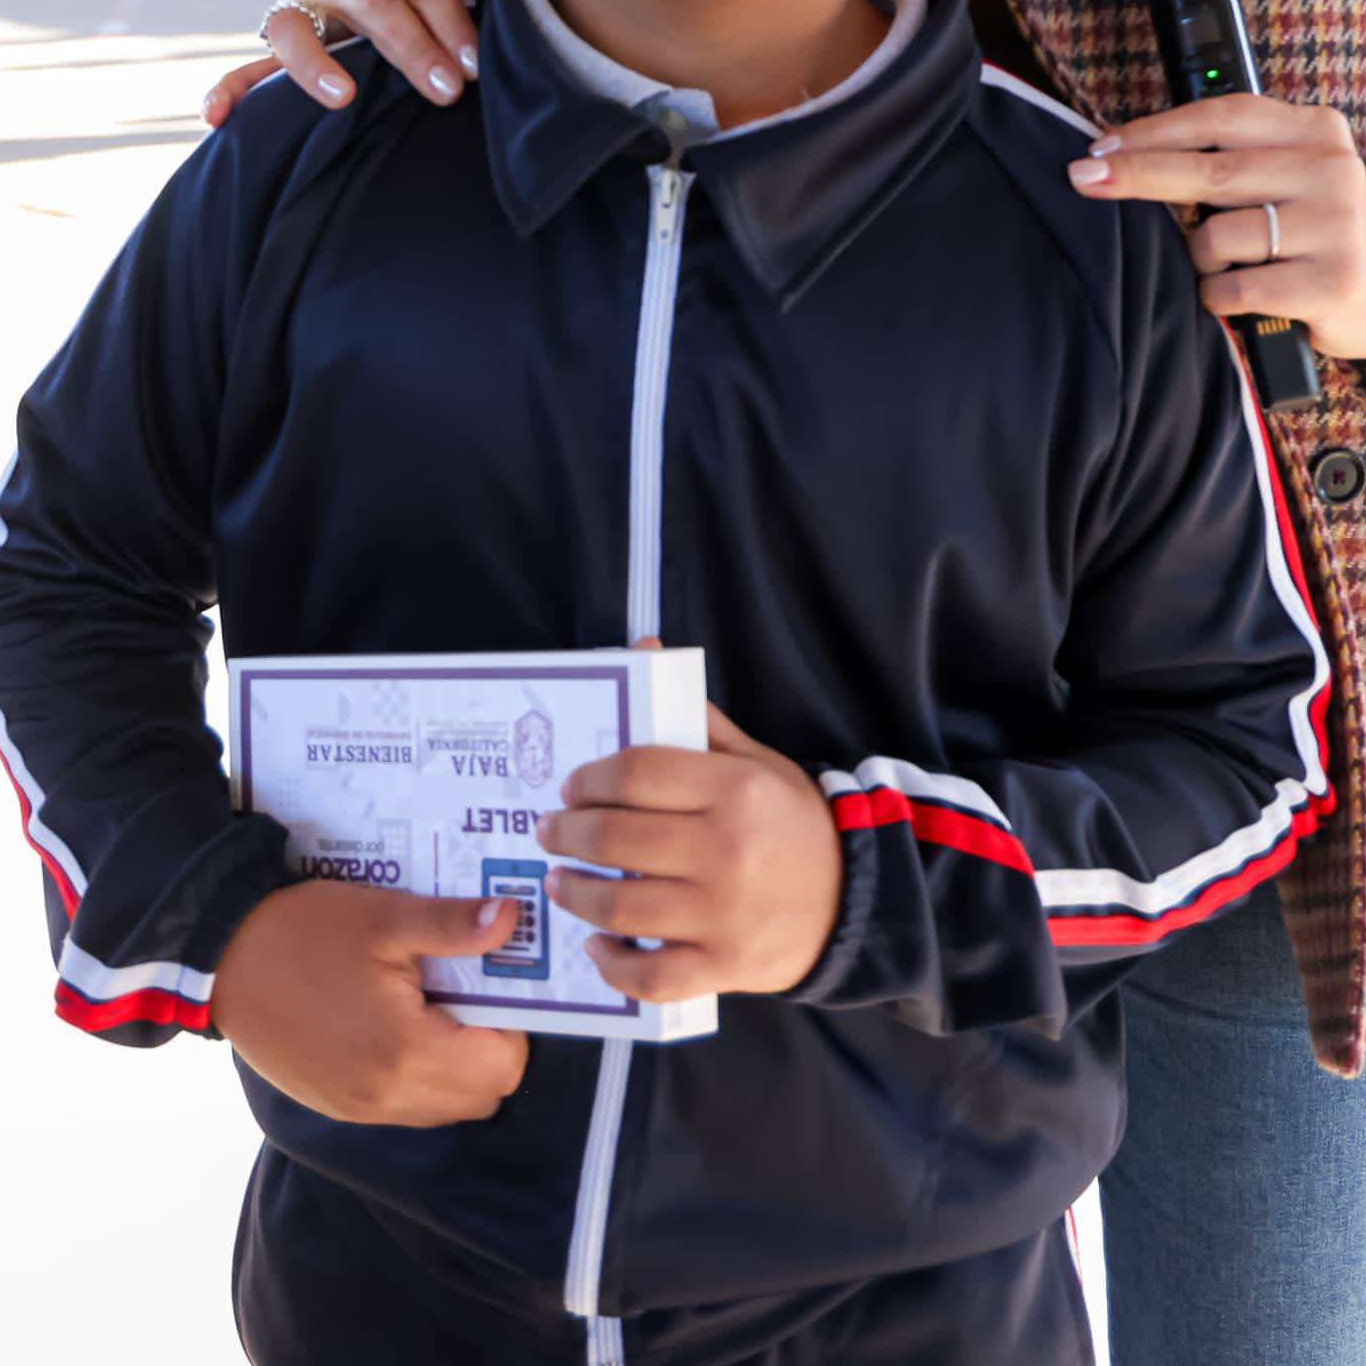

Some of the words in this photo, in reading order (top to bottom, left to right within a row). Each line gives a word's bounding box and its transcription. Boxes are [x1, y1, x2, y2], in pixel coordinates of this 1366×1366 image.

[307, 743, 412, 763] BIENESTAR
[452, 755, 508, 777] BAJA
[461, 807, 539, 834] BLET
